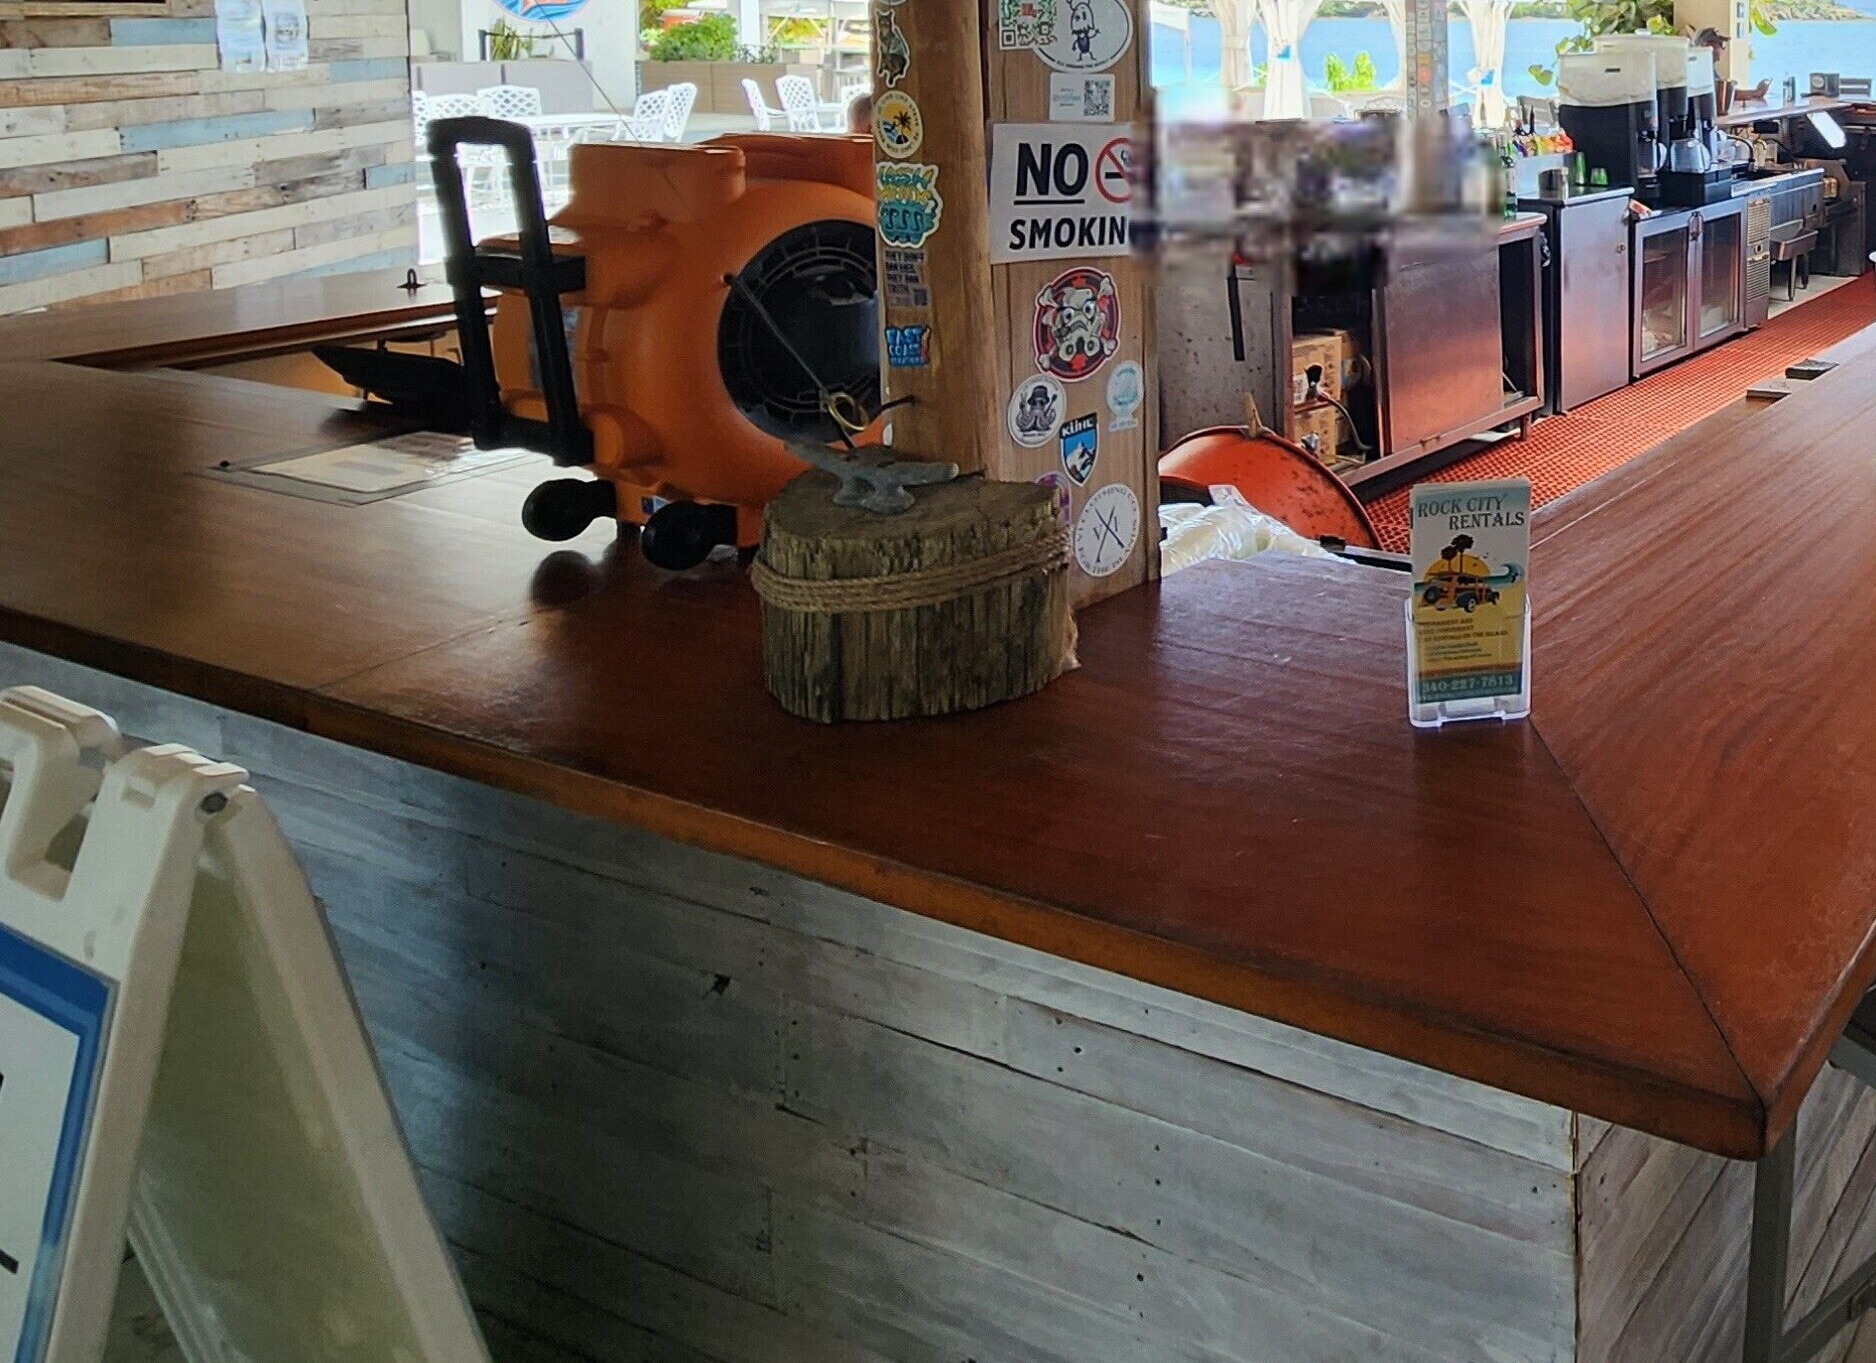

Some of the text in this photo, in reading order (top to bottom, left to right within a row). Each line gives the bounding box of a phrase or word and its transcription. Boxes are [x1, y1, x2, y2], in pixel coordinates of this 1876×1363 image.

[1015, 142, 1089, 196] NO
[1009, 216, 1126, 250] SMOKIN
[1417, 492, 1508, 518] ROCK CITY
[1449, 512, 1525, 531] RENTALS
